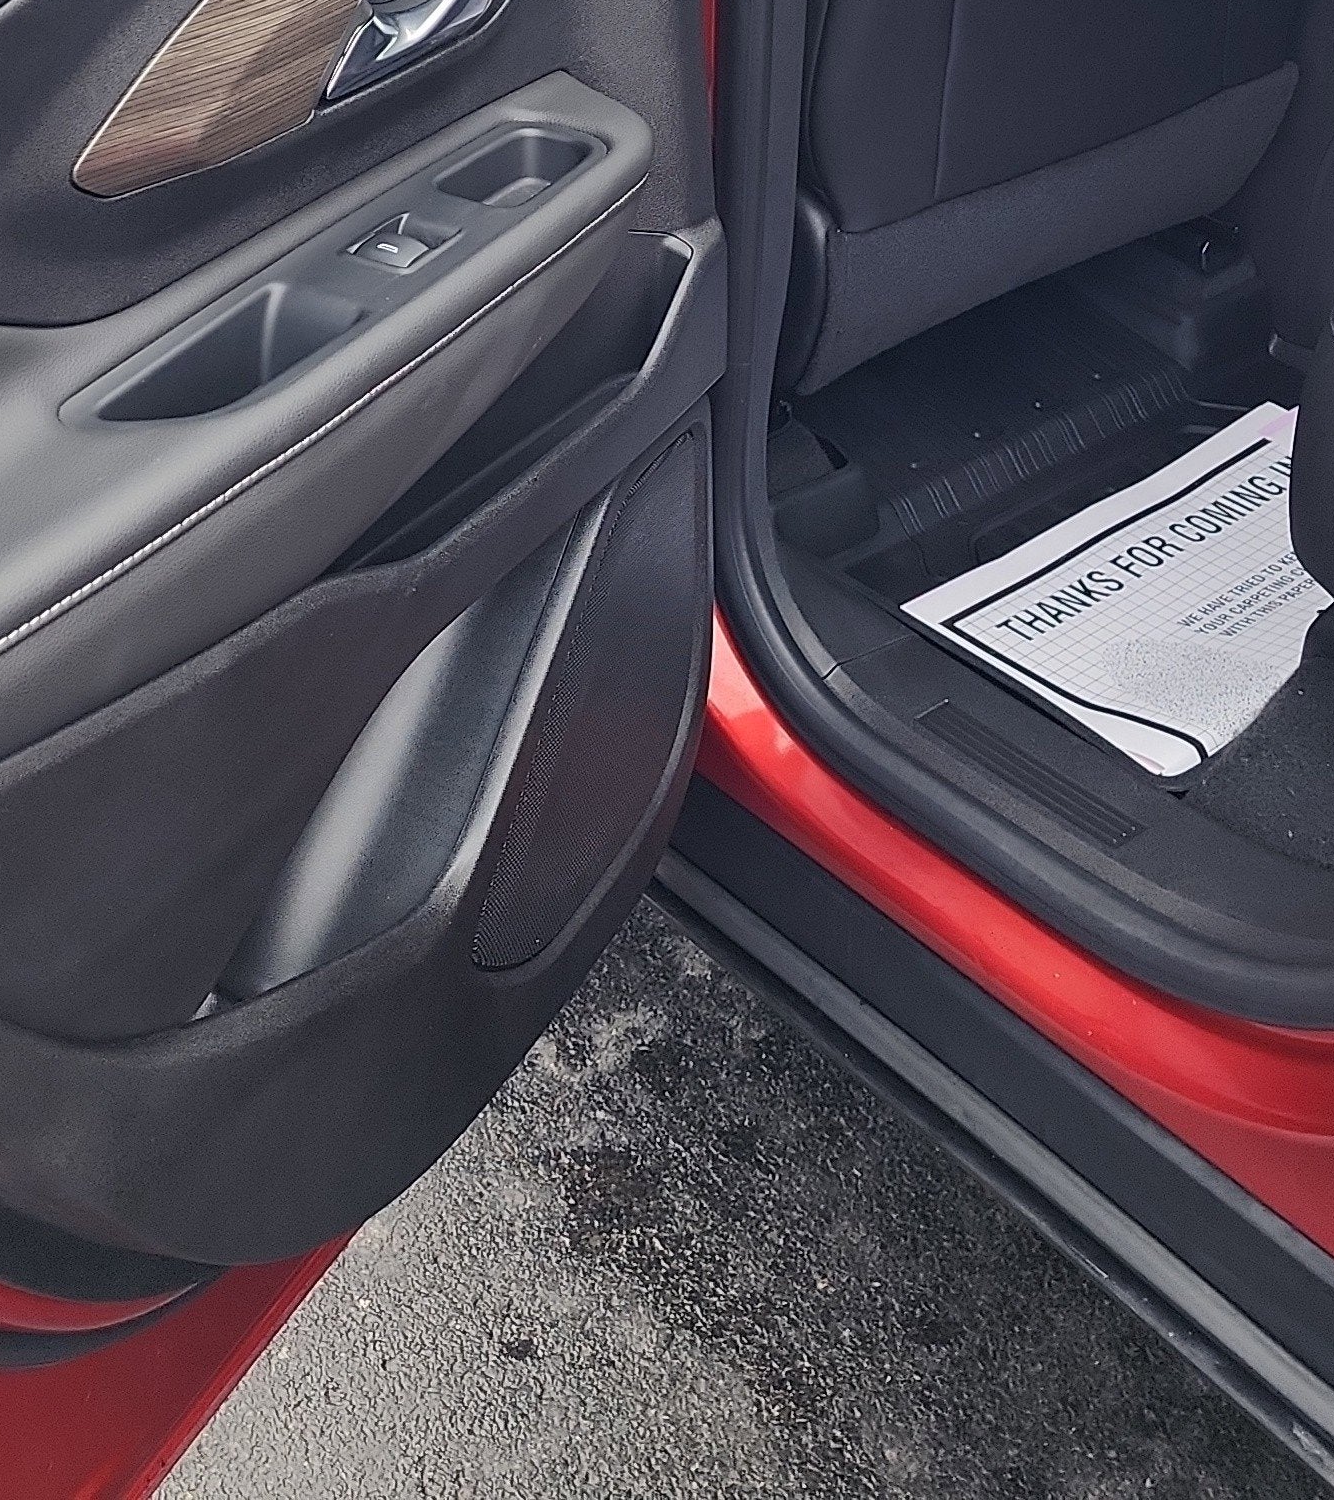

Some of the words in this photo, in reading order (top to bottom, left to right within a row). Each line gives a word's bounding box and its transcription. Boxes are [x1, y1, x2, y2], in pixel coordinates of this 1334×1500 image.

[995, 570, 1124, 641] THANKS
[1109, 535, 1185, 579] FOR
[1169, 475, 1287, 542] COMING
[1177, 612, 1203, 628] WE
[1202, 593, 1234, 619] HAVE
[1227, 574, 1267, 597] TRIED
[1261, 563, 1283, 579] TO
[1194, 612, 1234, 636] YOUR
[1229, 575, 1295, 616] CARPETING
[1219, 616, 1257, 638] WITH
[1251, 598, 1283, 620] THIS
[1278, 578, 1316, 602] PAPER
